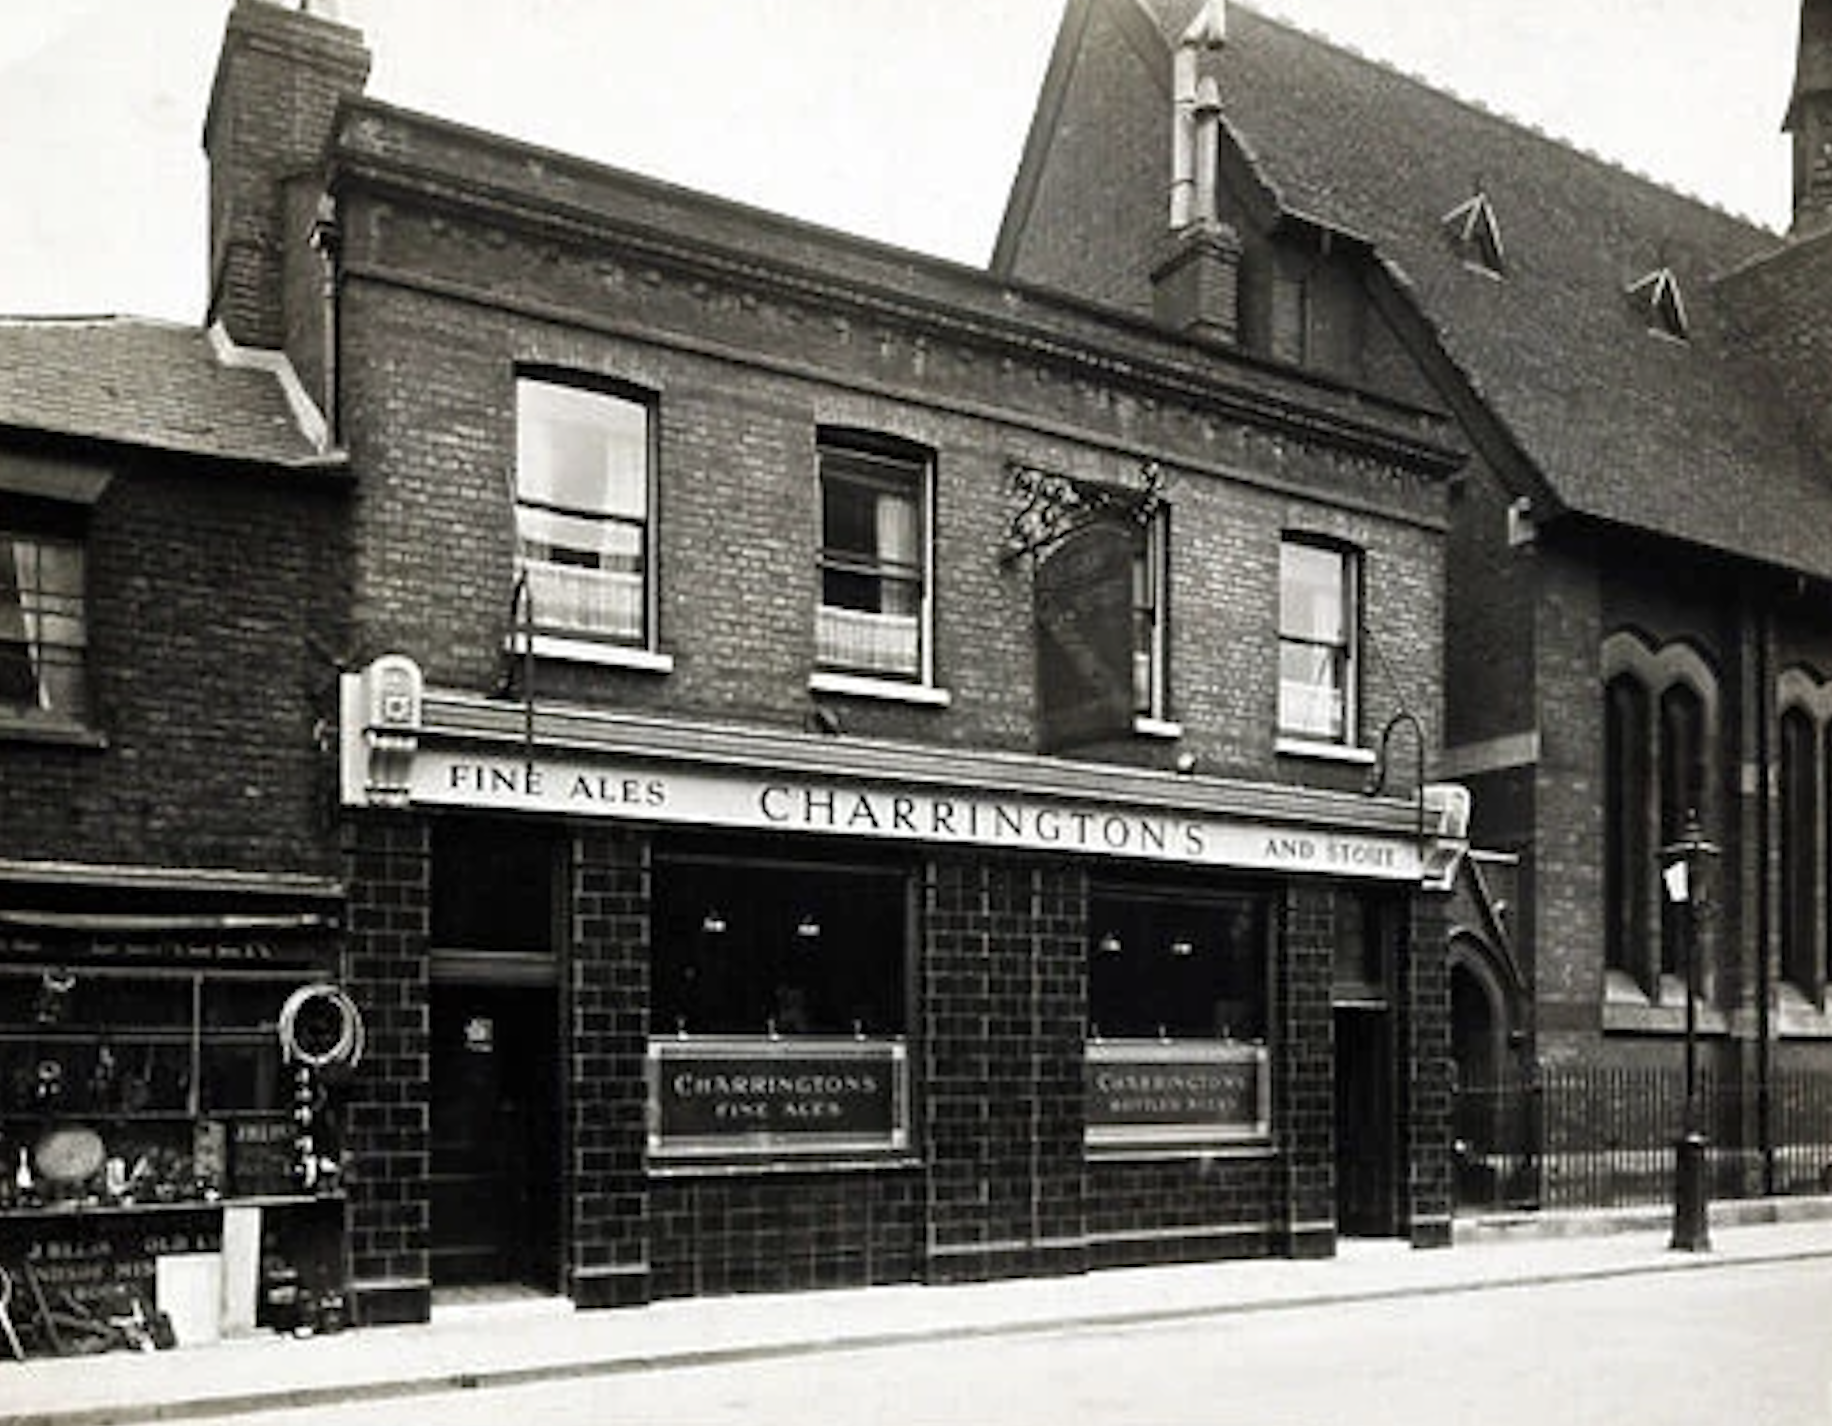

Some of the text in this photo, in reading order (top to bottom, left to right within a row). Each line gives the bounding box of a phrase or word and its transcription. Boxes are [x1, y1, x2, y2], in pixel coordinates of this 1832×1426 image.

[451, 765, 666, 806] FINE ALES
[1266, 839, 1315, 860] AND
